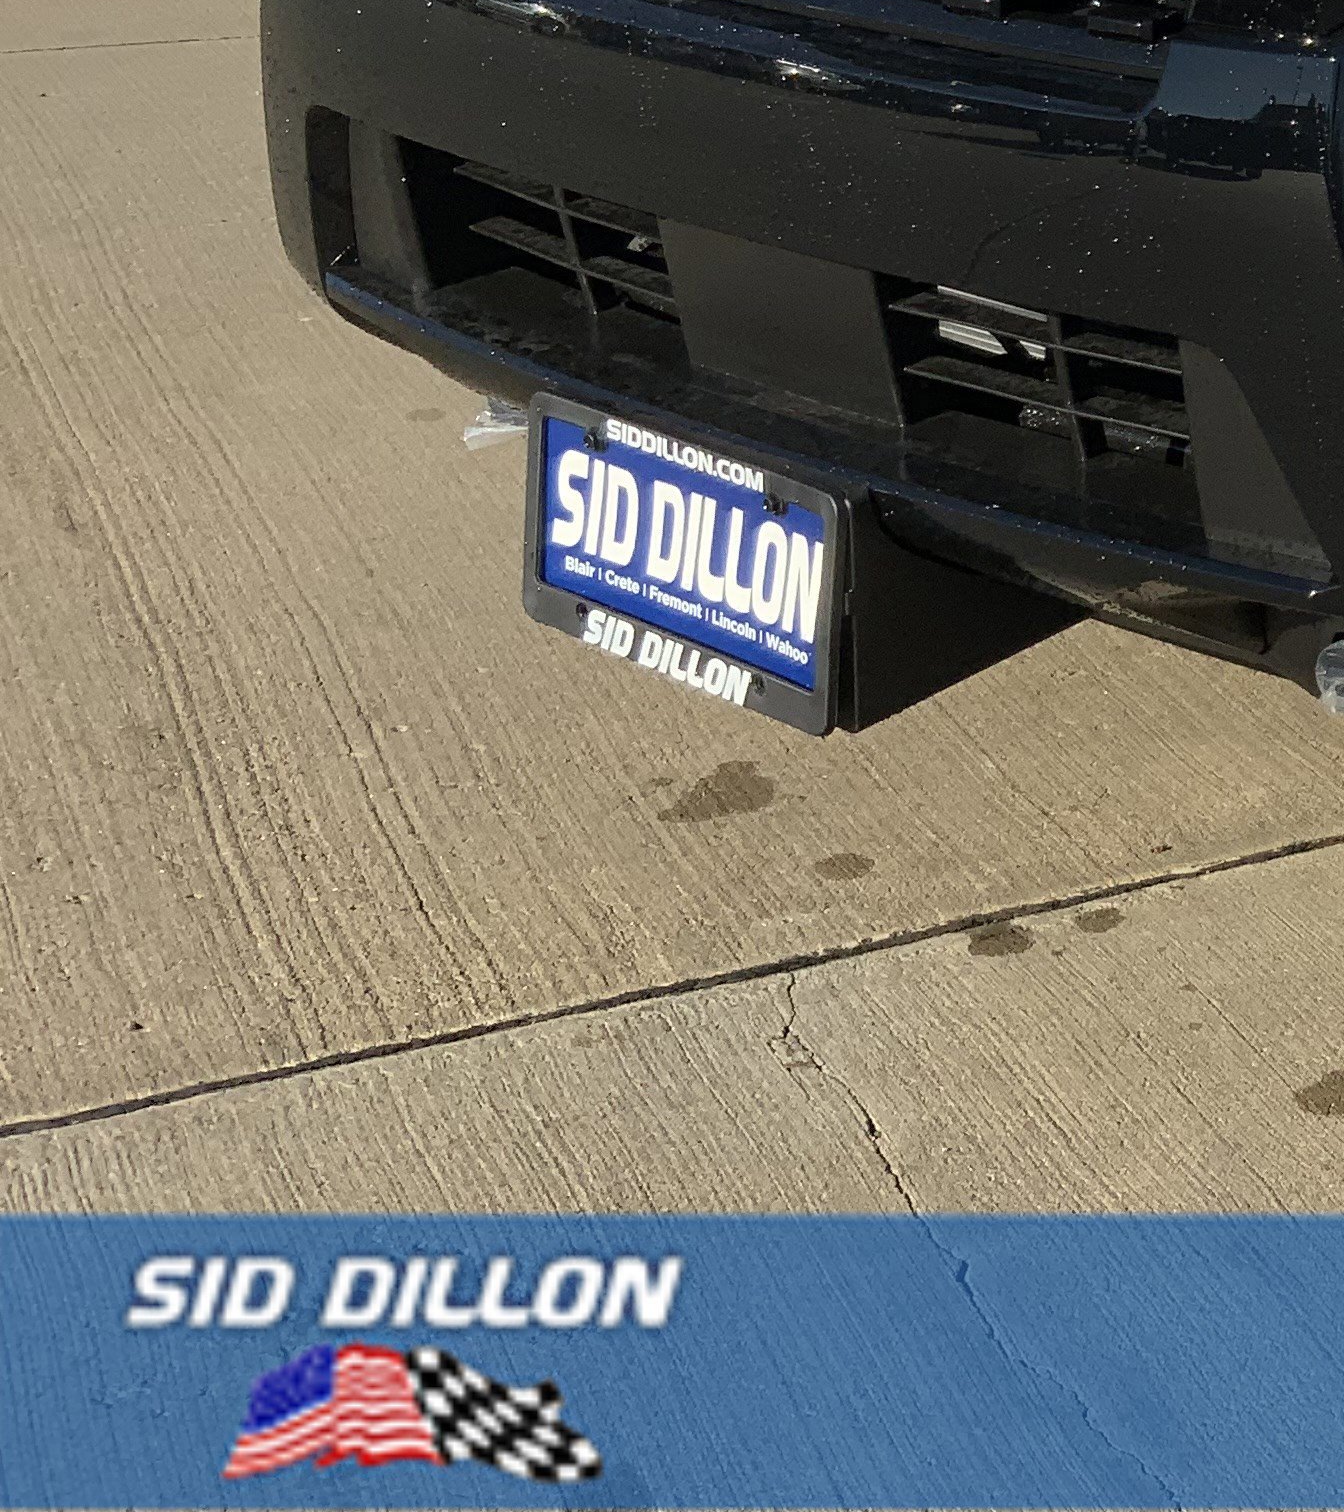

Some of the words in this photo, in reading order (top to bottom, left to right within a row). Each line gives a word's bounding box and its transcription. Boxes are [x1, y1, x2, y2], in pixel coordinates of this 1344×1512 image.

[606, 419, 765, 493] SIDDILLON.COM
[552, 449, 640, 567] SID
[647, 479, 824, 645] DILLON
[565, 555, 595, 580] Blair
[605, 569, 640, 595] Crete
[649, 581, 703, 619] Fremont
[712, 607, 757, 642] Lincoln
[765, 631, 810, 665] Wahoo
[583, 609, 635, 659] SID
[637, 630, 753, 707] DILLON
